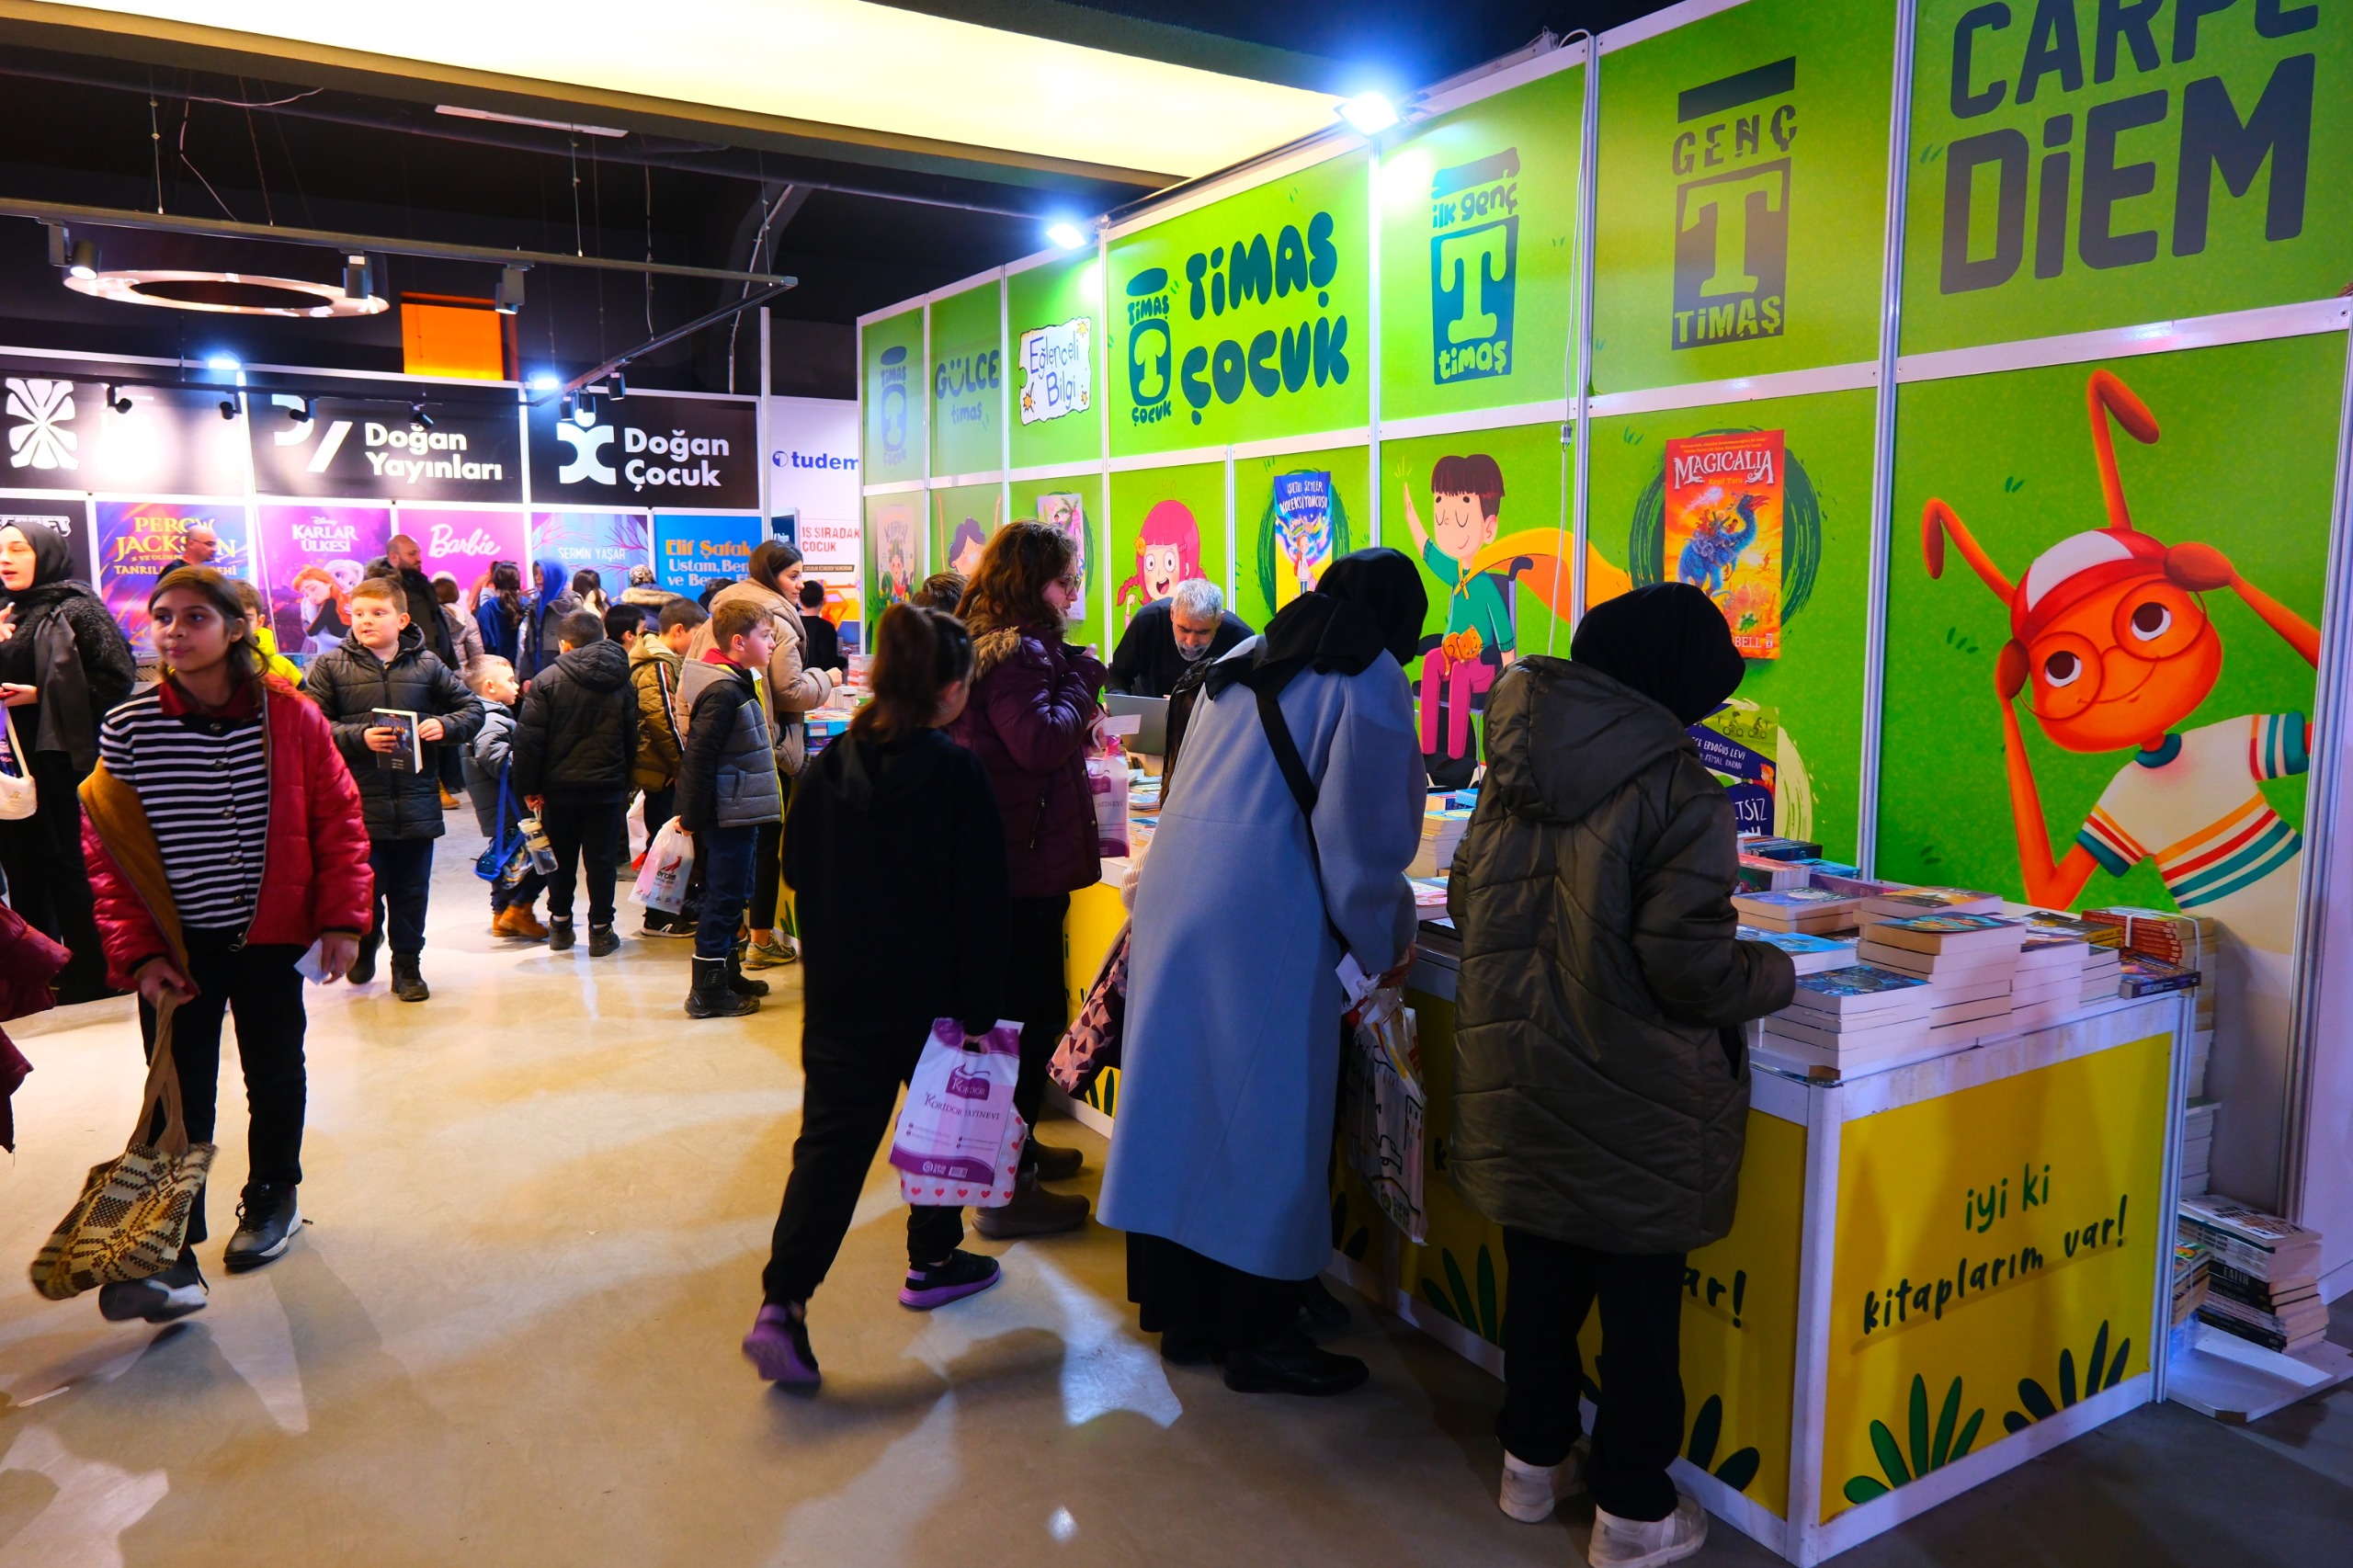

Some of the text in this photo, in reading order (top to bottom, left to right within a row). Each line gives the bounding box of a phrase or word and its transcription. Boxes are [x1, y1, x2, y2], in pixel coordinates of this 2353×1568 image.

[1672, 104, 1799, 176] GENÇ
[1939, 52, 2316, 295] DİEM
[1432, 182, 1518, 229] ilk genç
[1185, 211, 1337, 321] TİMAŞ
[1127, 294, 1170, 326] TİMAŞ
[1674, 295, 1782, 344] TİMAŞ
[1029, 330, 1079, 379] Eğlenceli
[1180, 315, 1349, 426] ÇOCUK
[1438, 340, 1507, 380] timaş
[935, 349, 1000, 399] GÜLCE
[1046, 371, 1077, 411] Bilgi
[1131, 400, 1172, 426] ÇOCUK
[365, 422, 467, 455] Doğan
[624, 427, 730, 461] Doğan
[365, 451, 503, 483] Yayınları
[625, 459, 722, 492] Çocuk
[791, 451, 858, 470] tudem
[1674, 449, 1774, 490] MAGICALIA
[113, 535, 237, 562] JACKSN
[291, 524, 360, 541] KARLAR
[300, 538, 351, 552] ÜLKESİ
[428, 523, 501, 558] Barbie
[558, 546, 626, 562] SERMİN YAŞAR
[665, 539, 752, 560] Elif Şafak
[667, 575, 685, 586] ve
[669, 559, 749, 574] Ustam, Ben
[1733, 636, 1762, 649] BELL
[1730, 746, 1746, 760] LEVİ
[1734, 797, 1768, 822] TSİZ
[1965, 1163, 2051, 1233] iyi ki
[1863, 1194, 2128, 1335] kitaplarım var!
[1682, 1267, 1746, 1329] ar!
